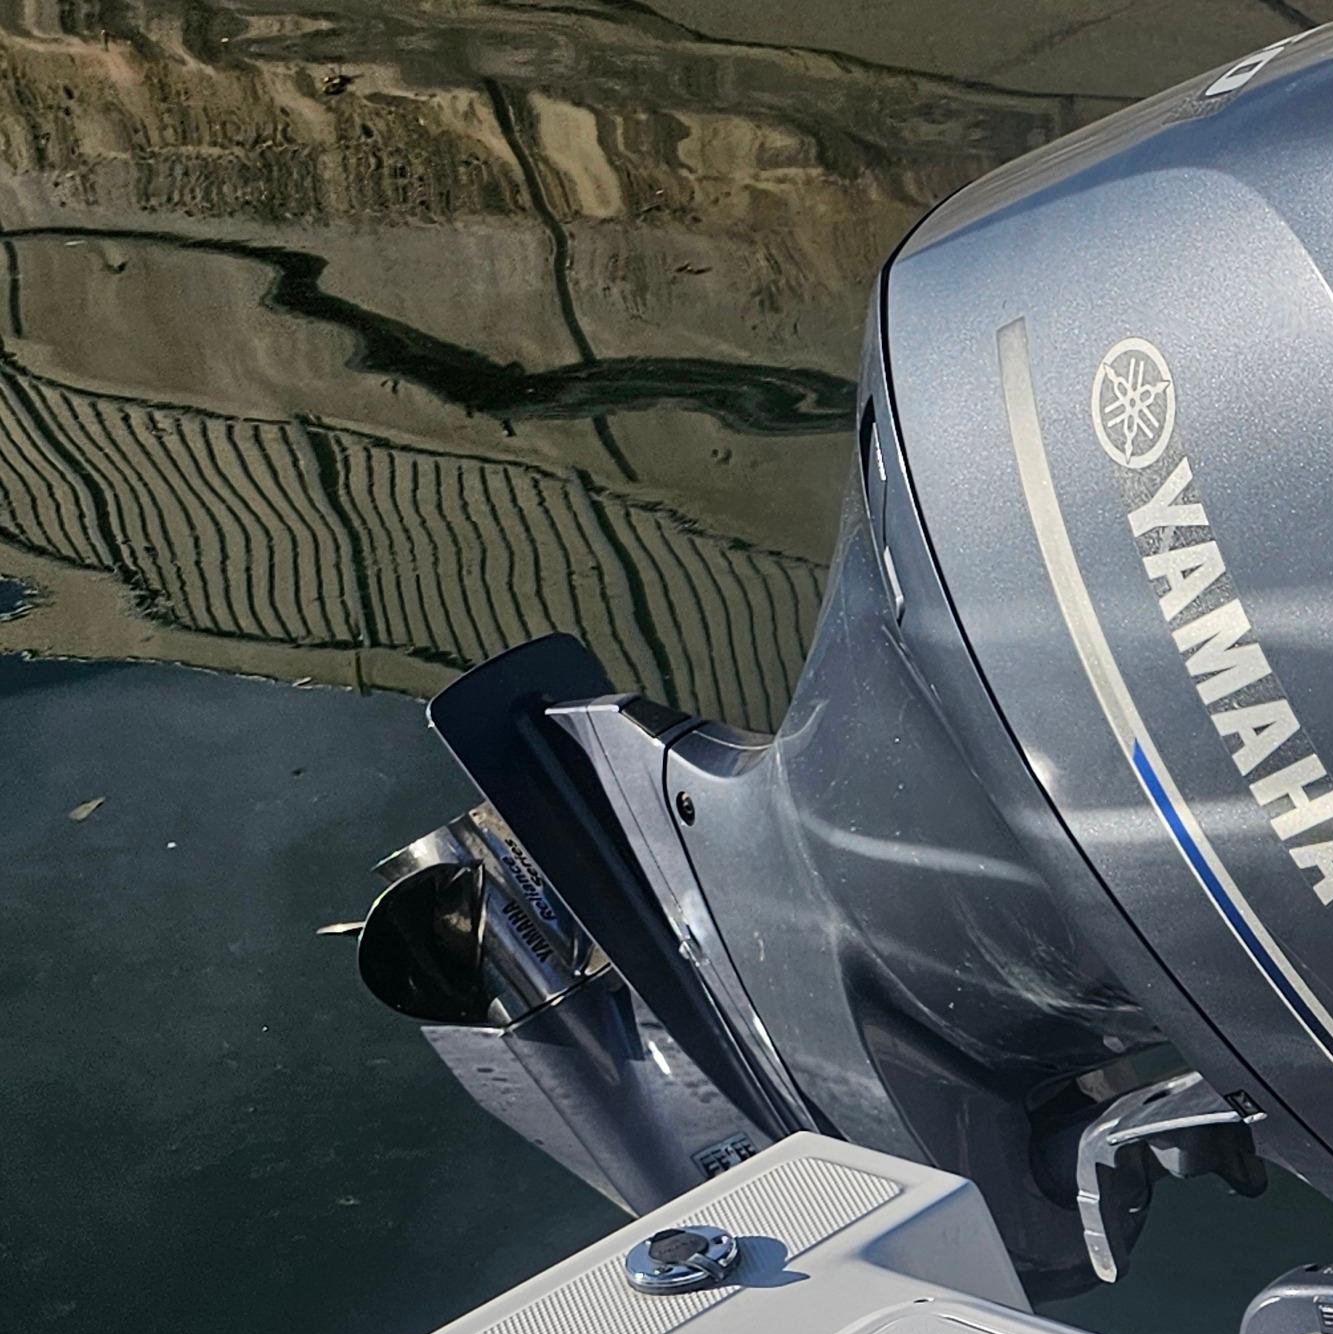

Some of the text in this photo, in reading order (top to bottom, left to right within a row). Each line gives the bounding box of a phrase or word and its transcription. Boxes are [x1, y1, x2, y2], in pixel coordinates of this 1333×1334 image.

[502, 856, 557, 921] Reliance
[505, 838, 546, 887] Series
[502, 901, 553, 963] YAMAHA
